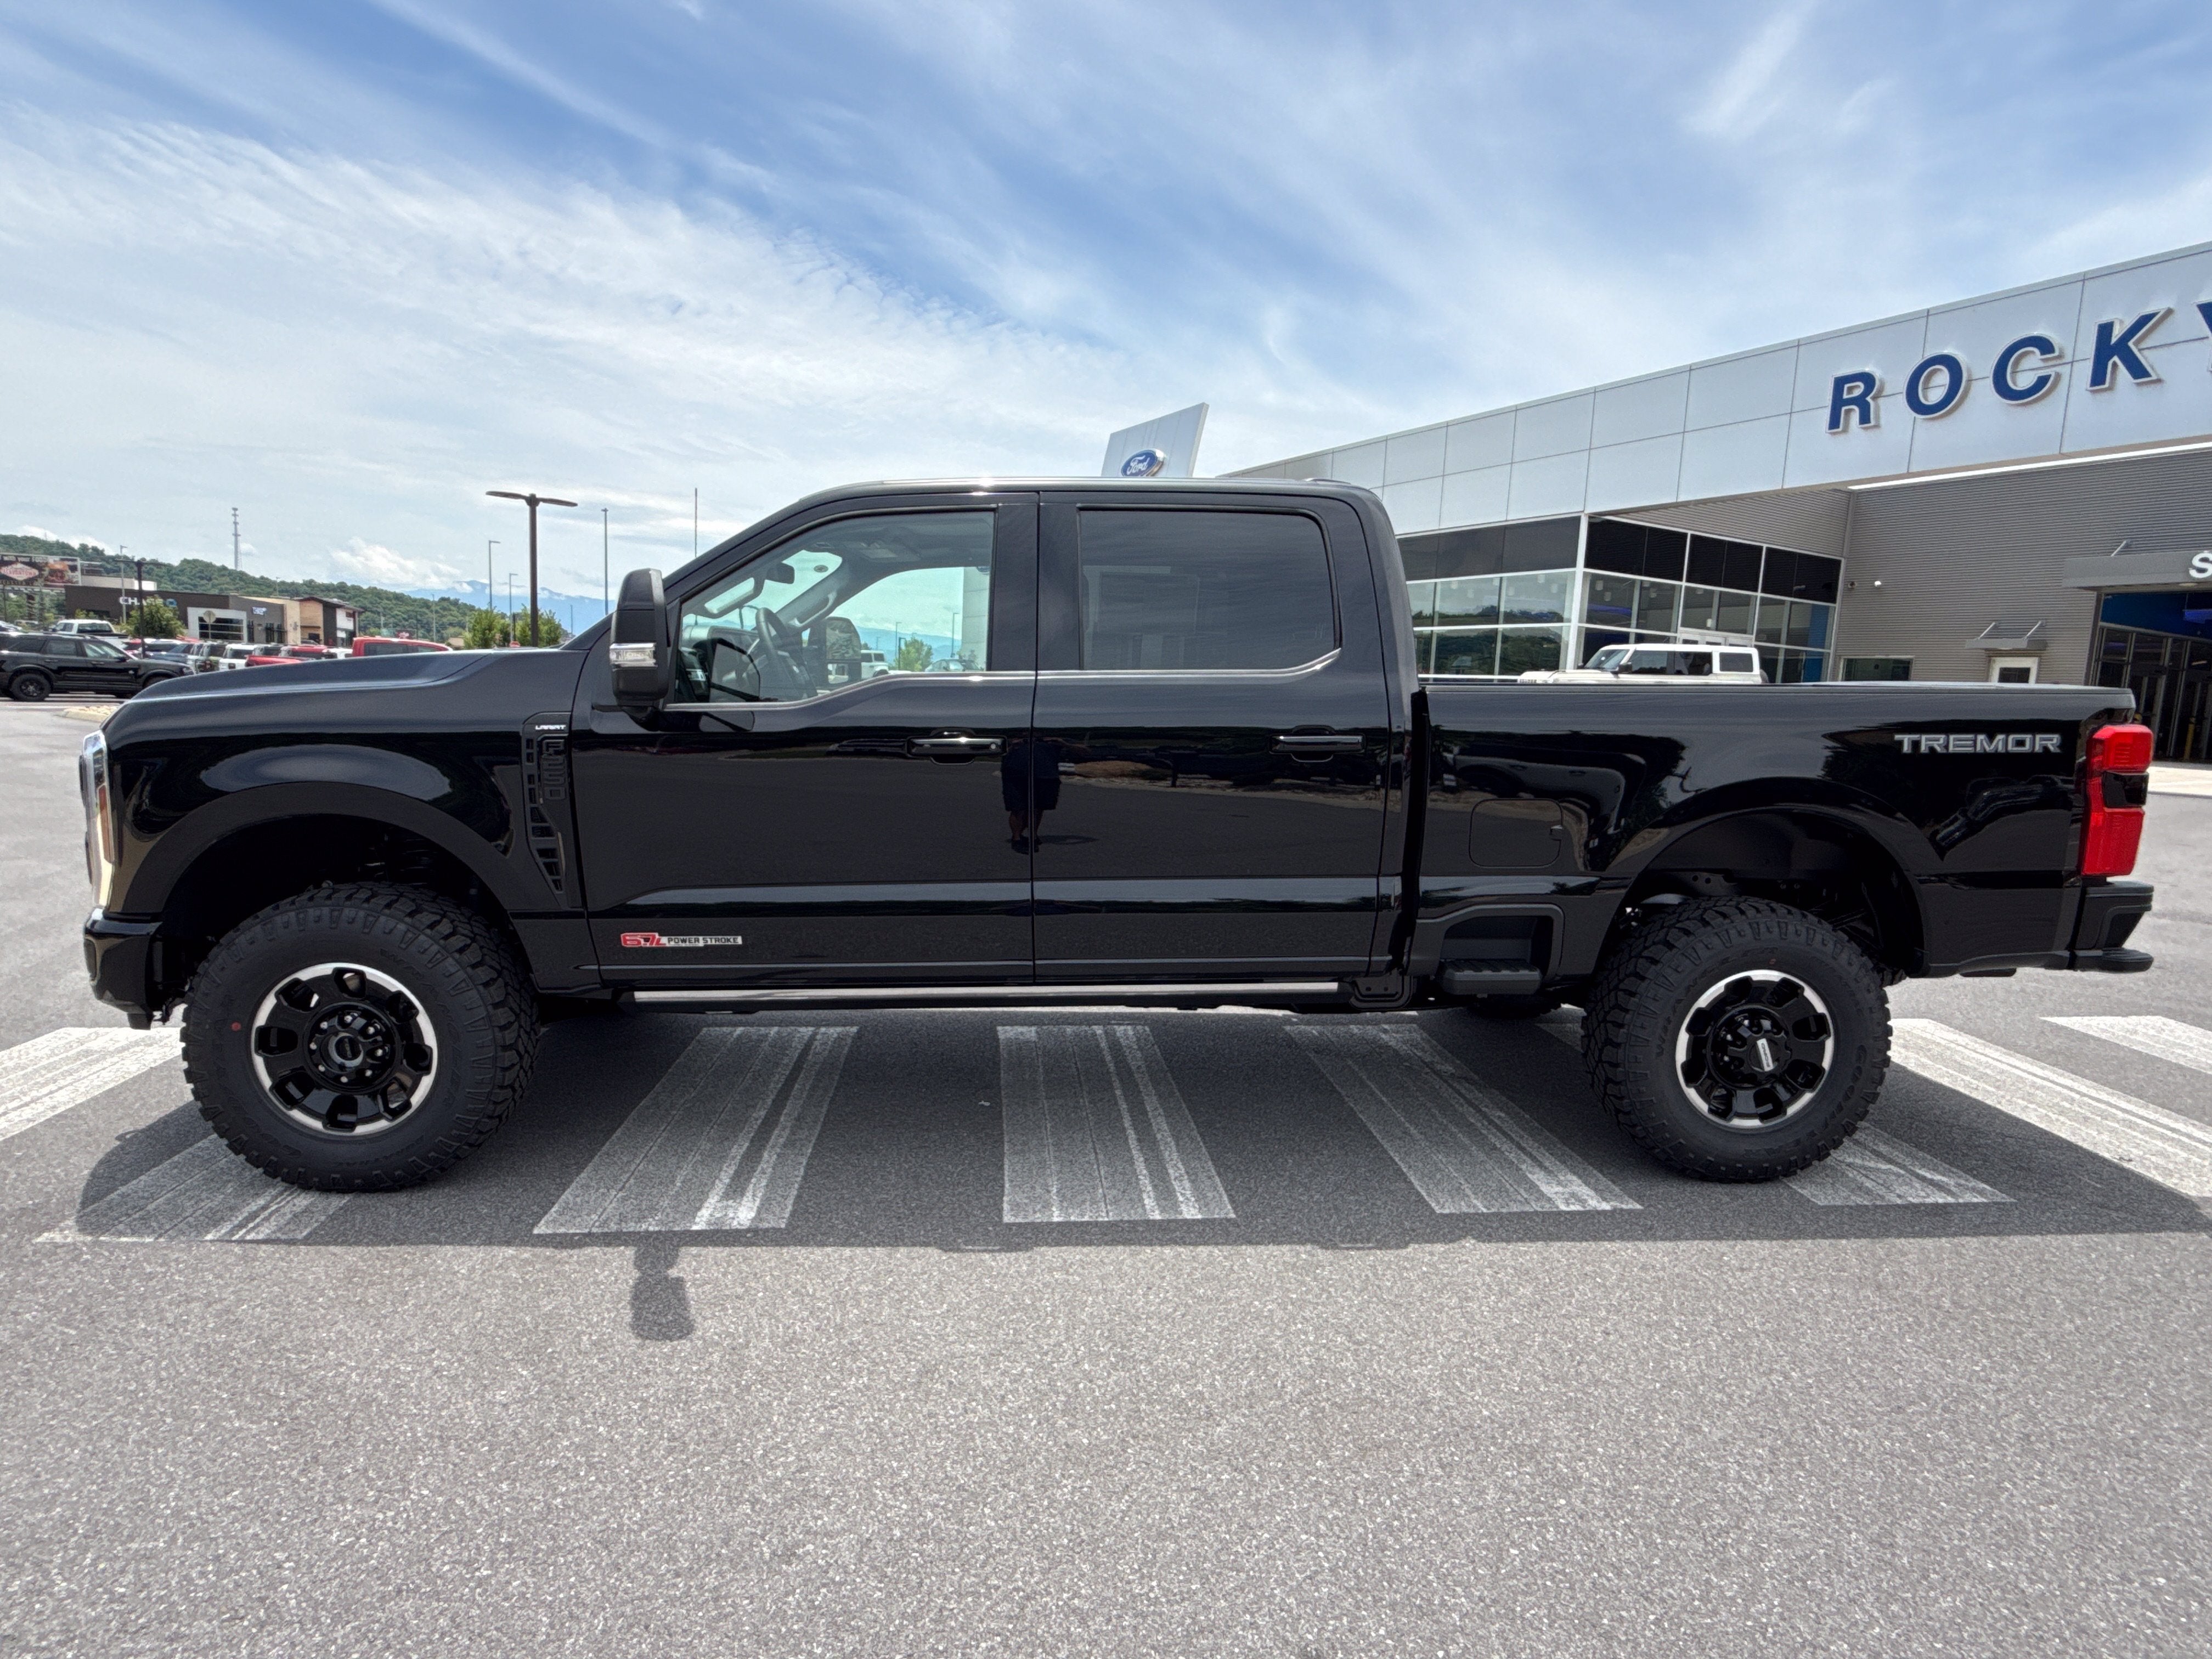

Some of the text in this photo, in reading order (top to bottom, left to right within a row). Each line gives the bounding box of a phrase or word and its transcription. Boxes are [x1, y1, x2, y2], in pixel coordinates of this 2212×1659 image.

[1826, 300, 2212, 433] ROCK
[1126, 455, 1150, 475] Ford
[1894, 733, 2062, 754] TREMOR
[621, 932, 667, 947] 6.7L
